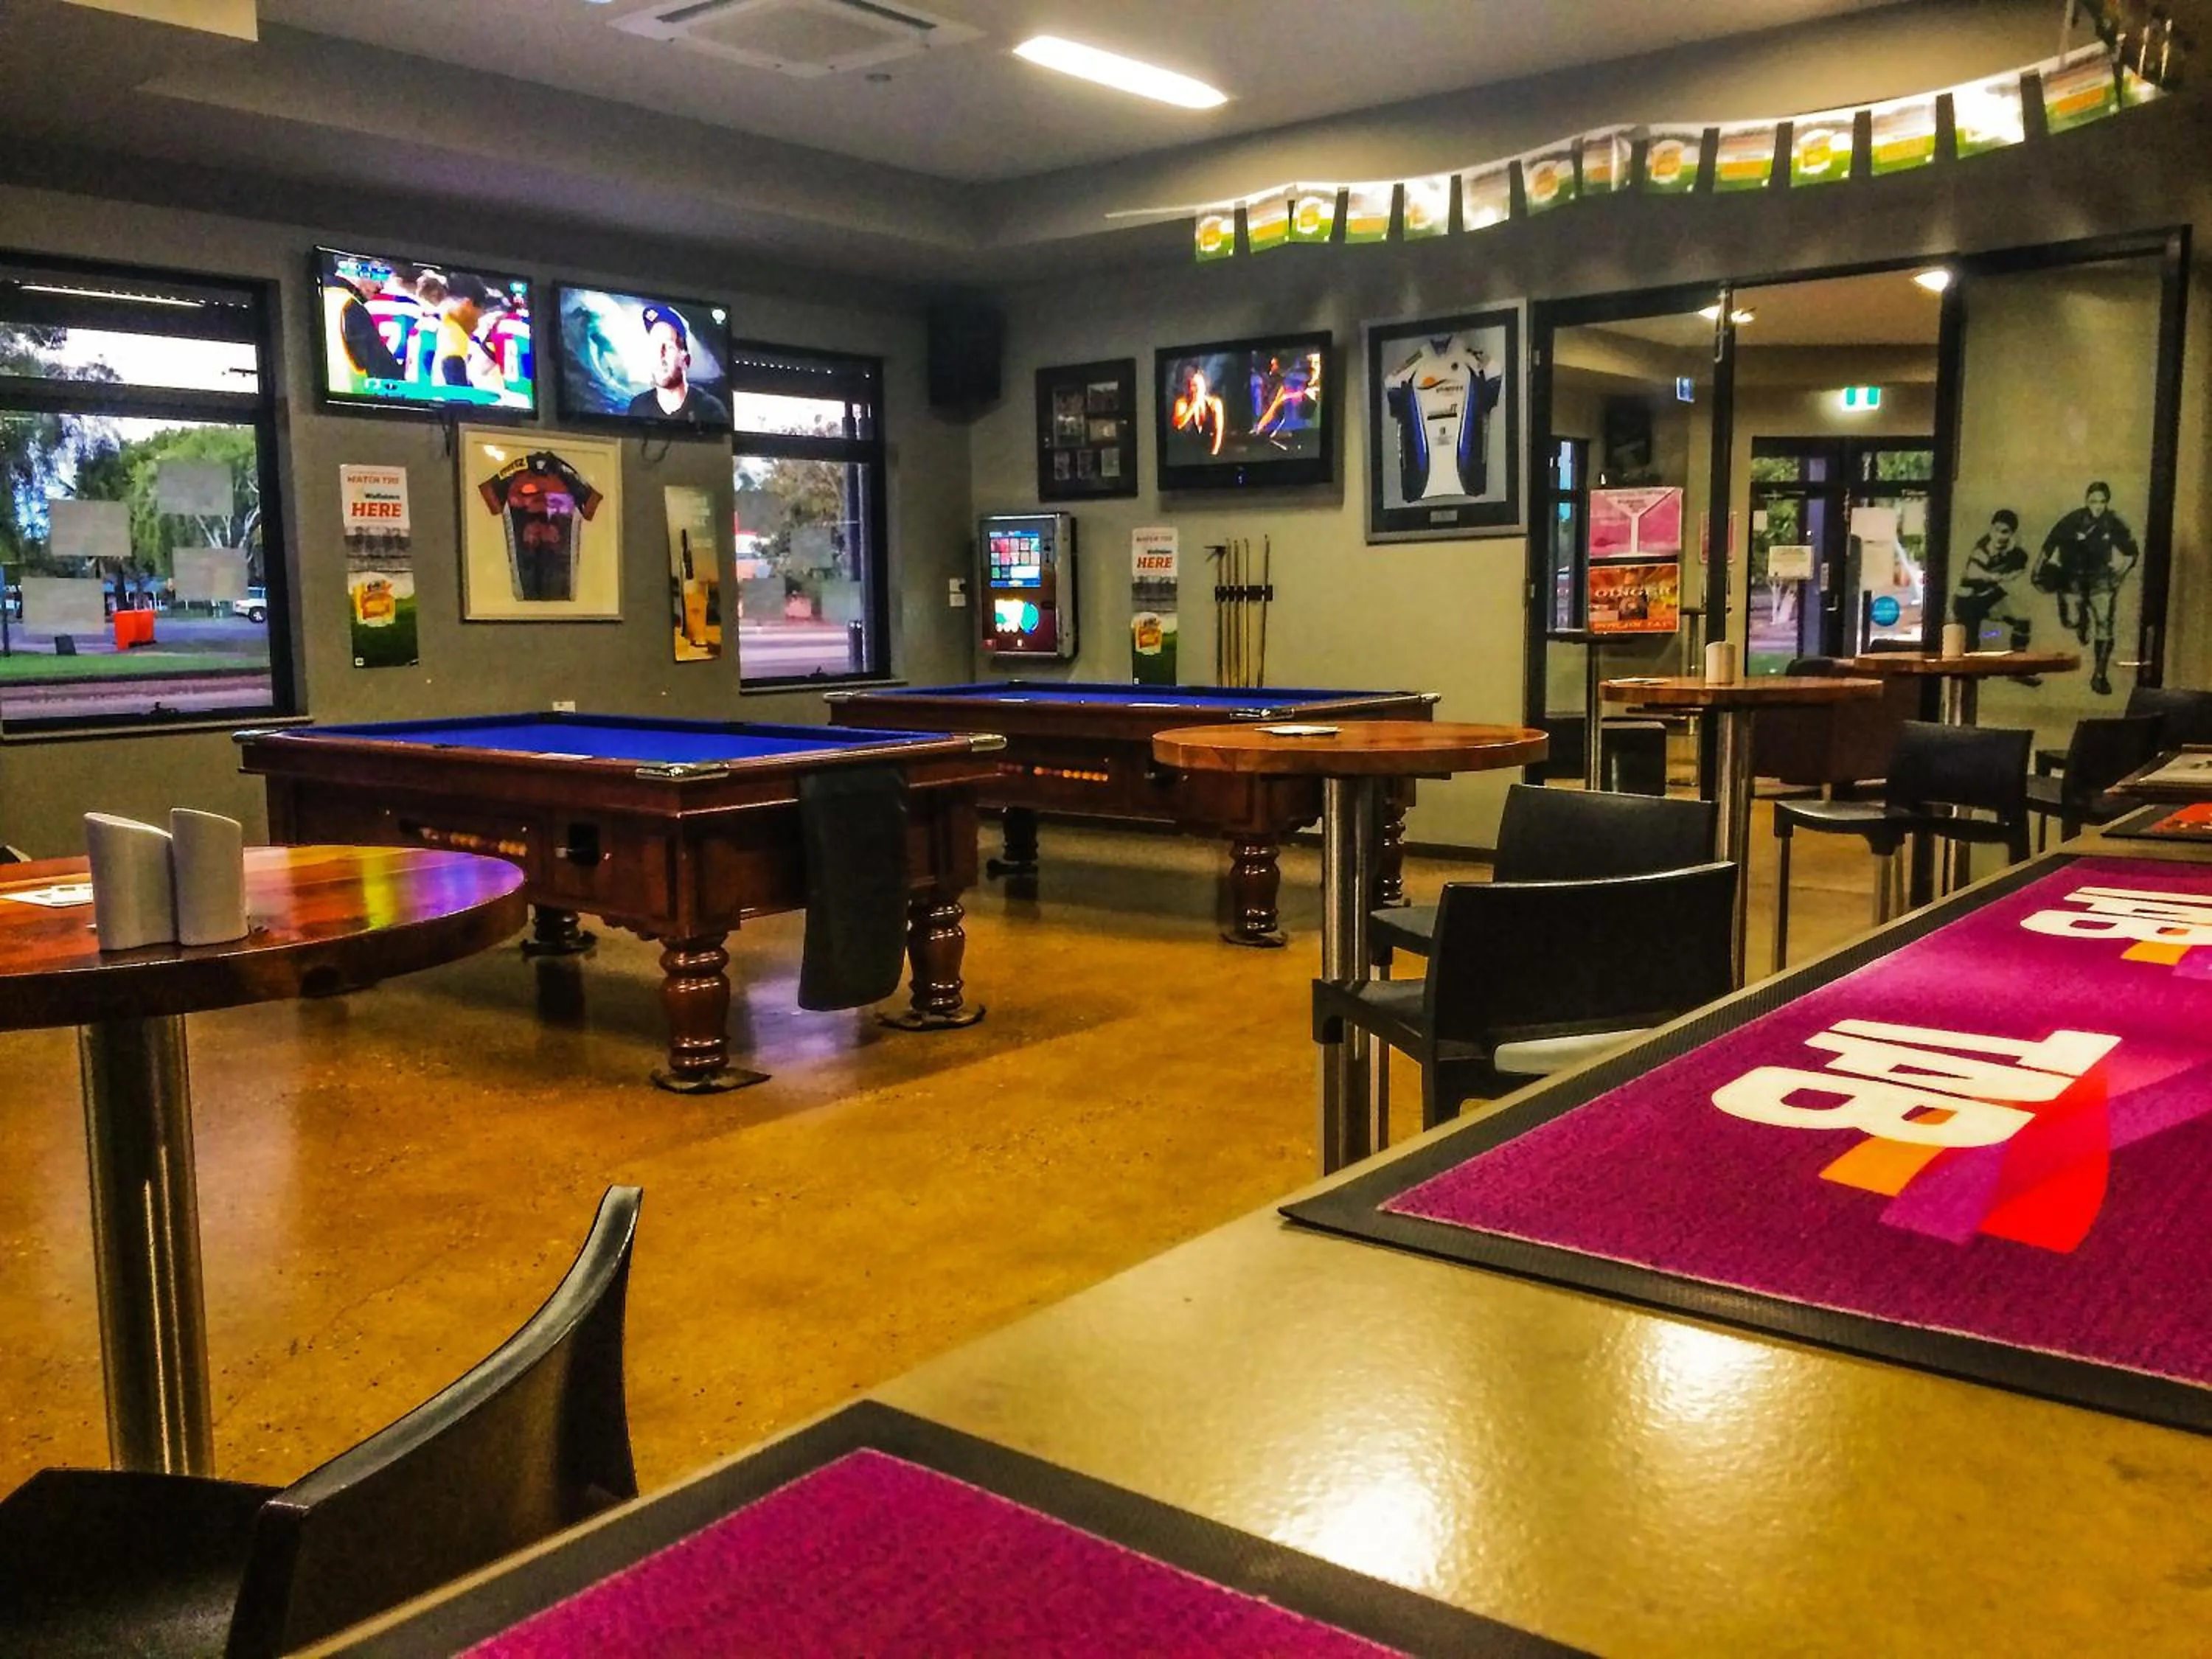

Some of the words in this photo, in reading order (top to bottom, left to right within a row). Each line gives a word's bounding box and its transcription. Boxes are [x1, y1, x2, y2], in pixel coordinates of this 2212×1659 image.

[352, 502, 402, 517] HERE
[1137, 557, 1173, 568] HERE
[1711, 1019, 2122, 1147] TAB
